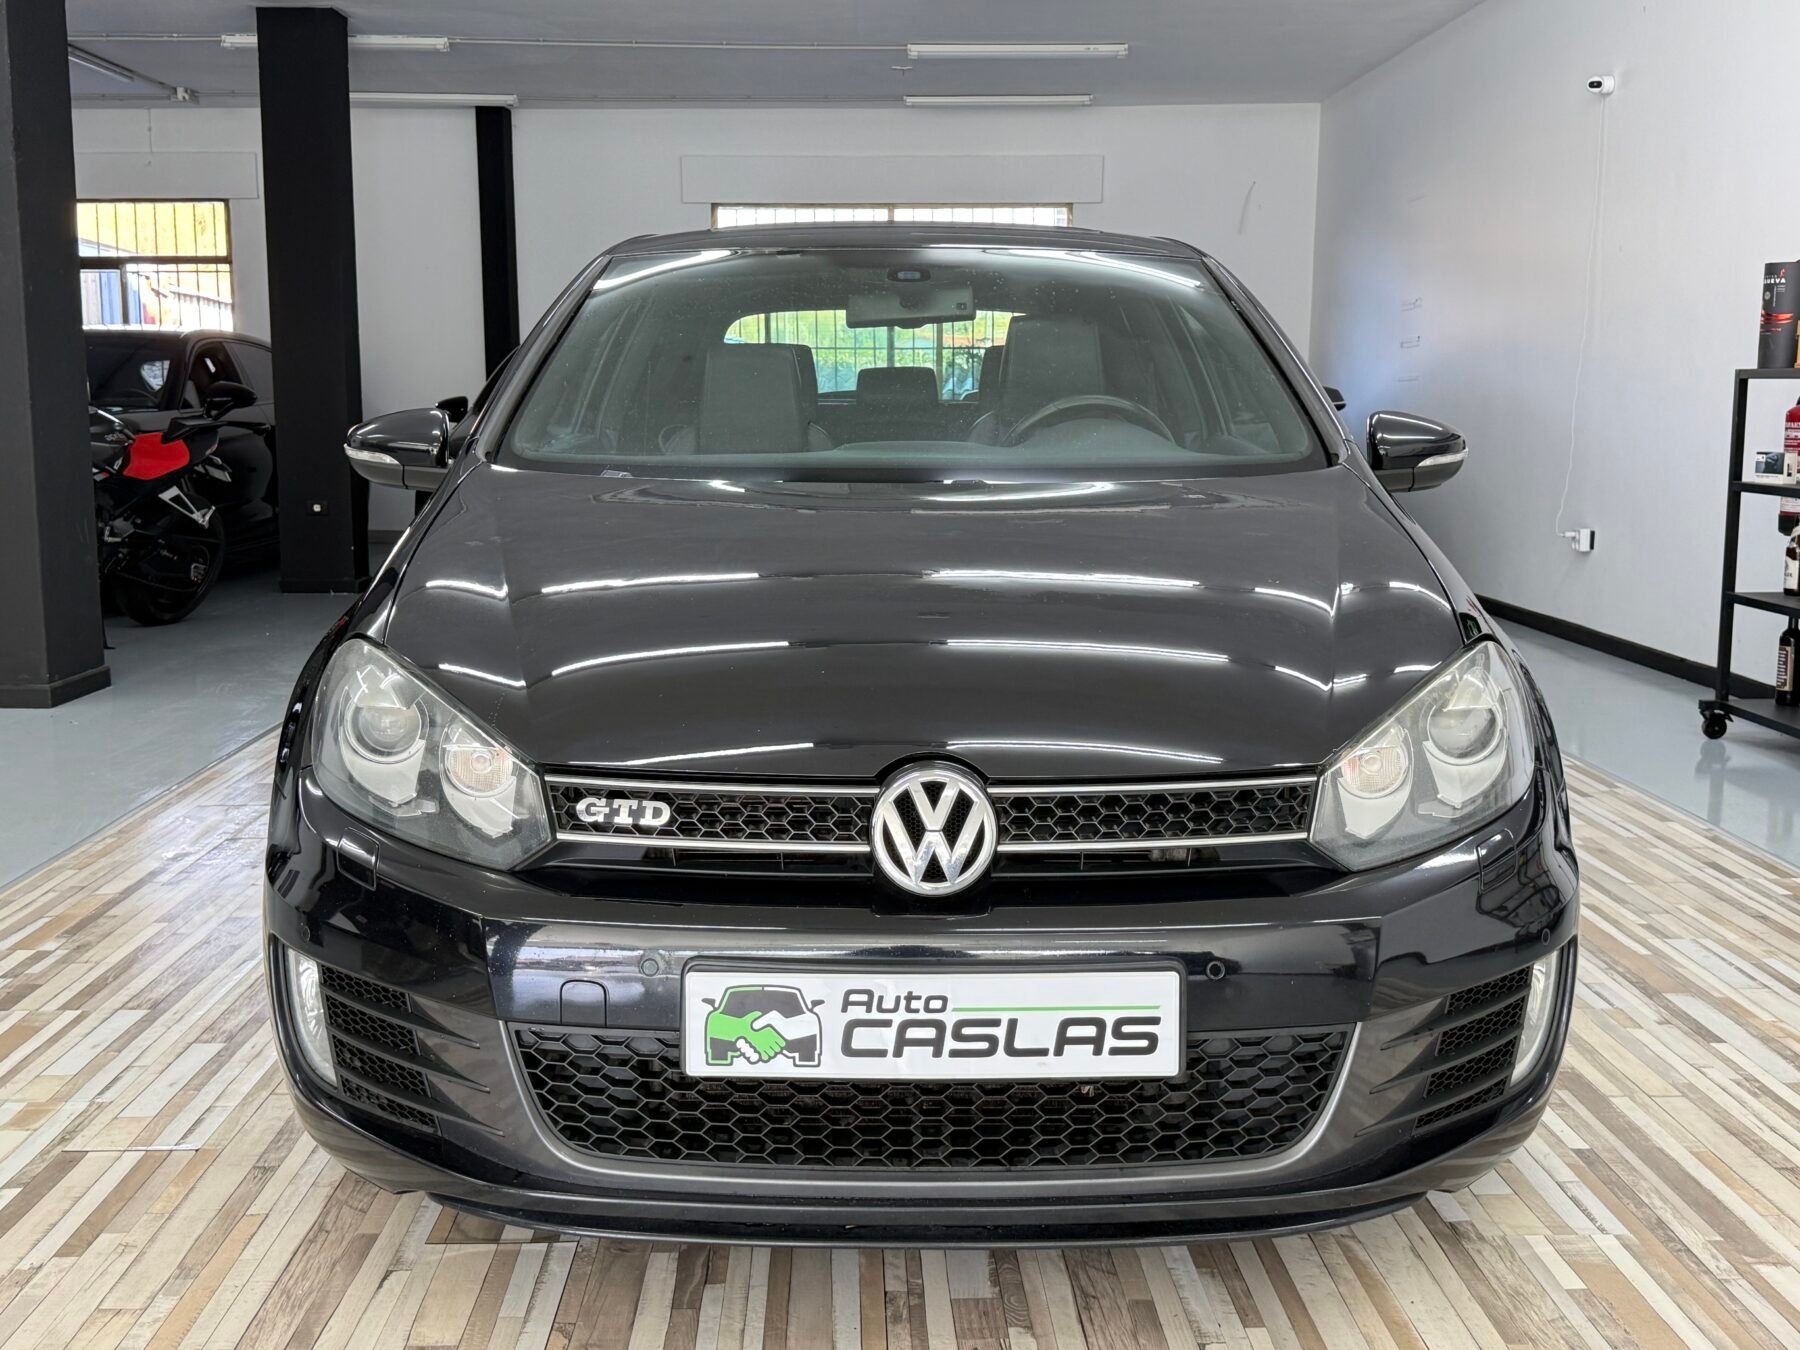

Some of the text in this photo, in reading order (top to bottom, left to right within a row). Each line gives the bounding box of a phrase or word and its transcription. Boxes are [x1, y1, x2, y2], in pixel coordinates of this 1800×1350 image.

[576, 797, 671, 826] GTD
[841, 989, 948, 1014] Auto
[840, 1016, 1162, 1059] CASLAS
